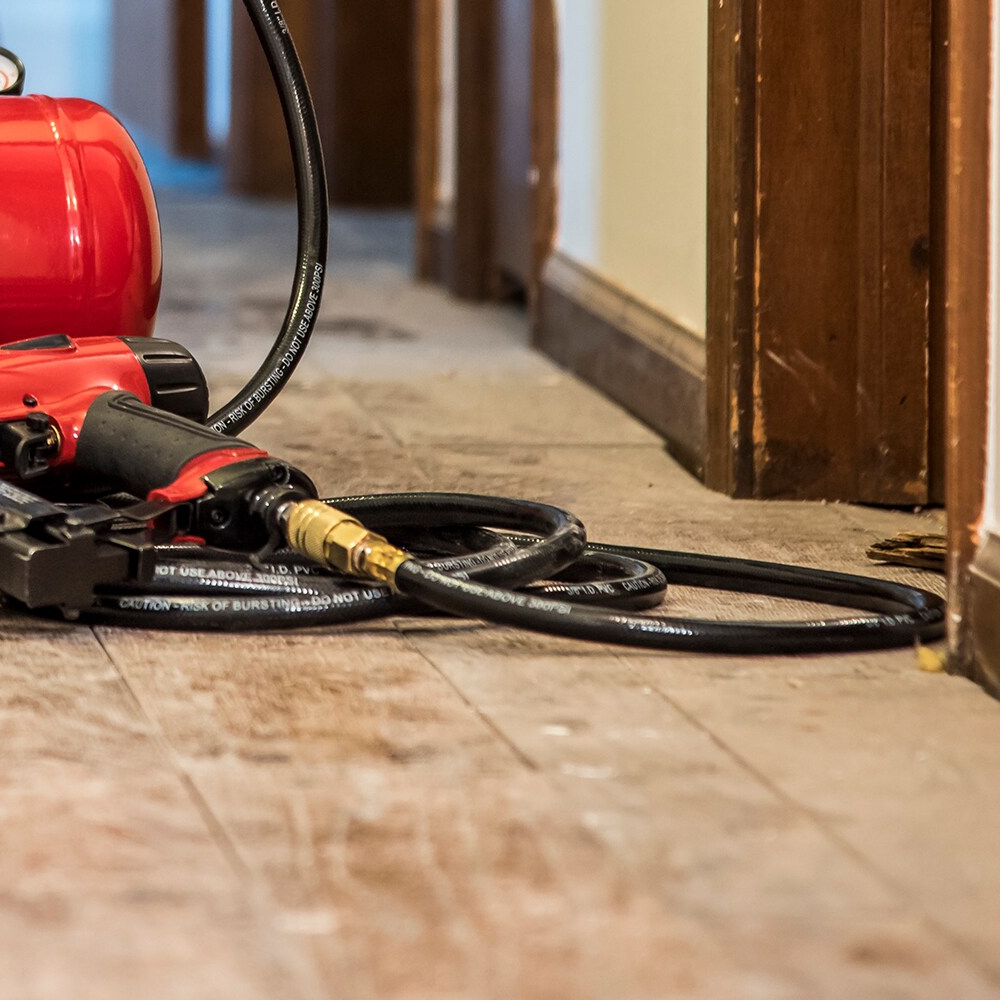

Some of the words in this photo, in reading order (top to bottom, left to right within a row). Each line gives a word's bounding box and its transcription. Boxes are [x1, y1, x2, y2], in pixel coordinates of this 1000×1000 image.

[311, 262, 324, 293] 300PSI
[306, 291, 319, 322] ABOVE
[297, 319, 310, 339] USE
[289, 335, 304, 356] NOT
[281, 352, 295, 367] DO
[253, 367, 285, 404] BURSTING
[245, 397, 257, 411] OF
[228, 406, 247, 424] RISK
[179, 567, 207, 578] USE
[206, 568, 251, 582] ABOVE
[119, 598, 171, 612] CAUTION
[181, 600, 209, 612] RISK
[212, 600, 231, 612] OF
[233, 597, 300, 612] BURSTING
[331, 591, 360, 605] NOT
[488, 587, 527, 607] ABOVE
